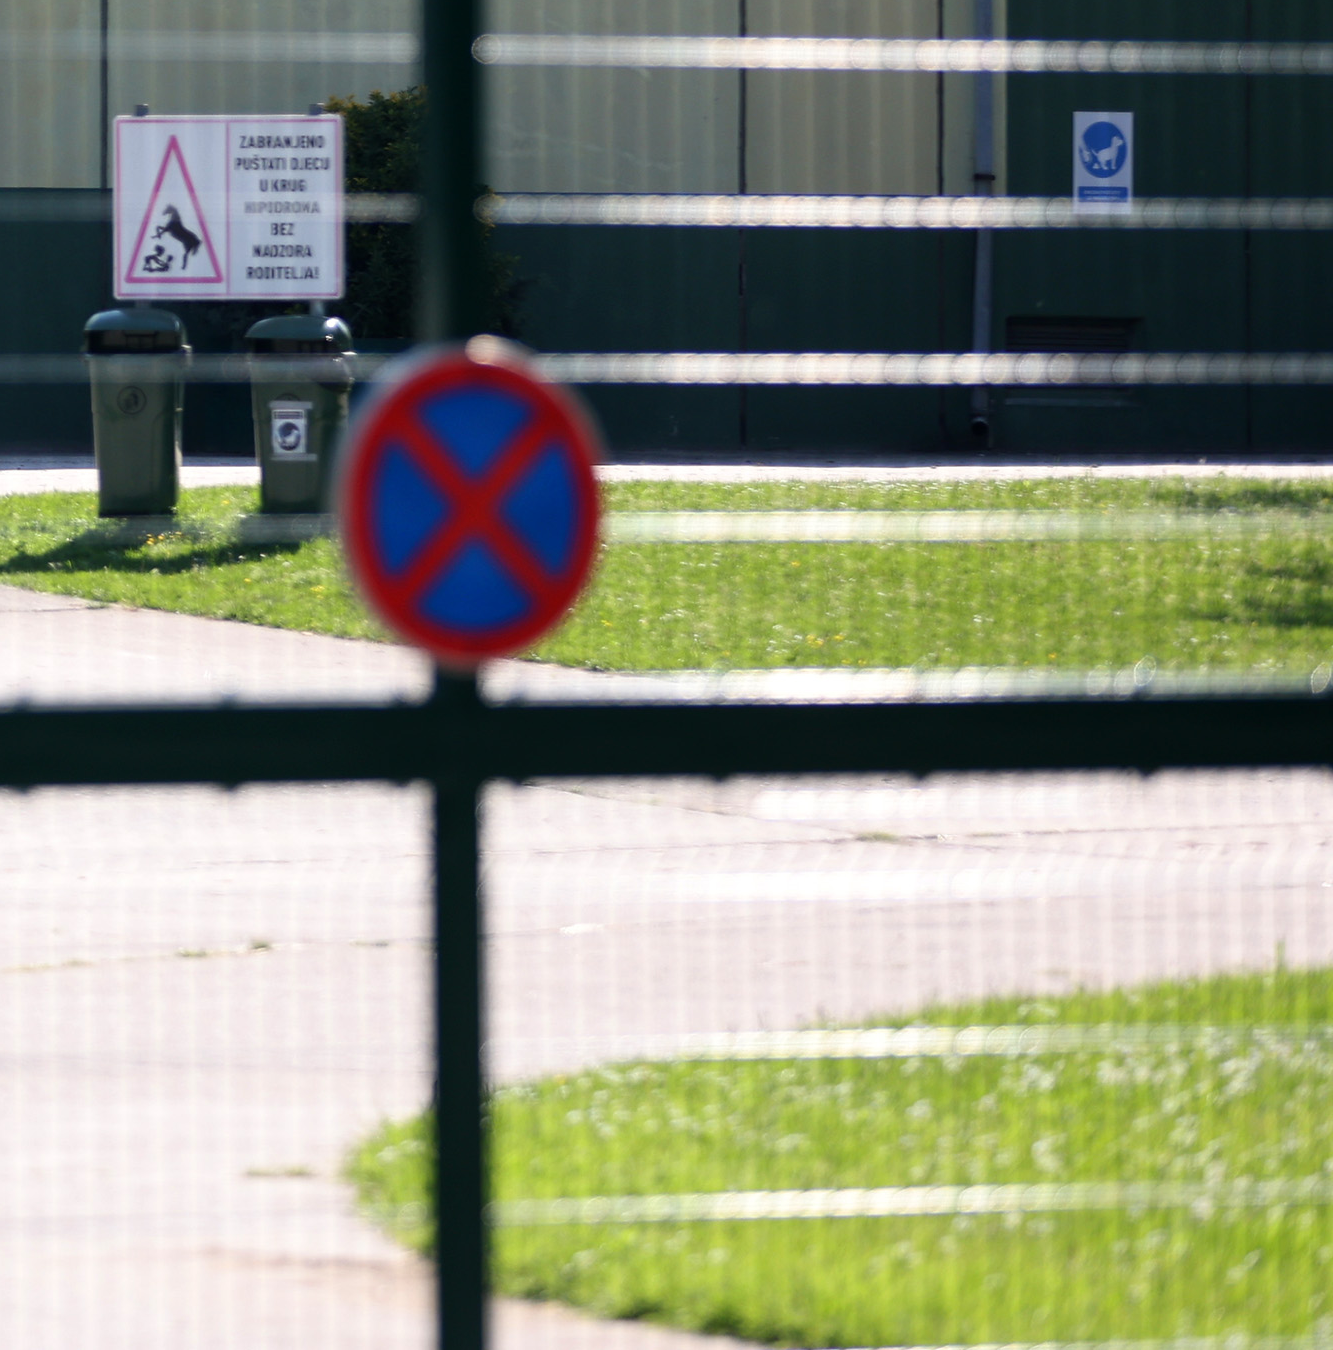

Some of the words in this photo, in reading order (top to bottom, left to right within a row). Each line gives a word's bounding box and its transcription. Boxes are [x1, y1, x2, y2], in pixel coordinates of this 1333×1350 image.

[239, 135, 325, 149] ZABRANJENO
[259, 180, 268, 192] U
[271, 180, 307, 192] KRUG
[270, 223, 295, 236] BEZ
[252, 245, 312, 258] NADZORA
